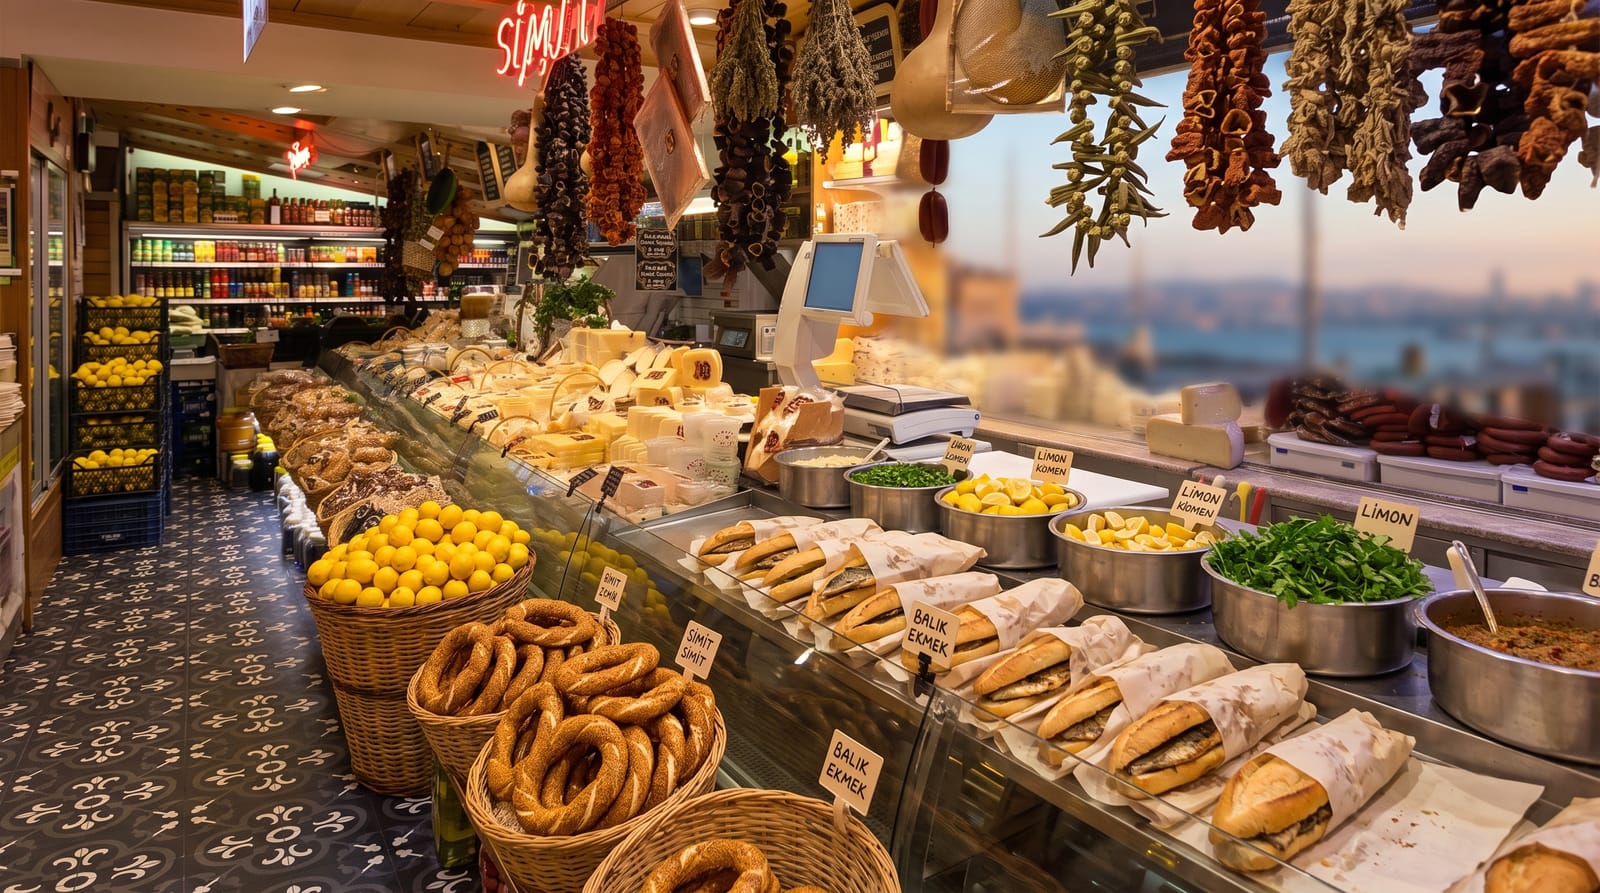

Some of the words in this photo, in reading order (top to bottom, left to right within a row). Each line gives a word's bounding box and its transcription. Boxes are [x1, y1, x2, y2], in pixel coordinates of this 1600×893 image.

[1361, 503, 1413, 527] LİMON
[913, 608, 948, 636] BALIK
[907, 627, 949, 658] EKMEK
[833, 741, 870, 776] BALIK
[826, 762, 867, 801] EKMEK
